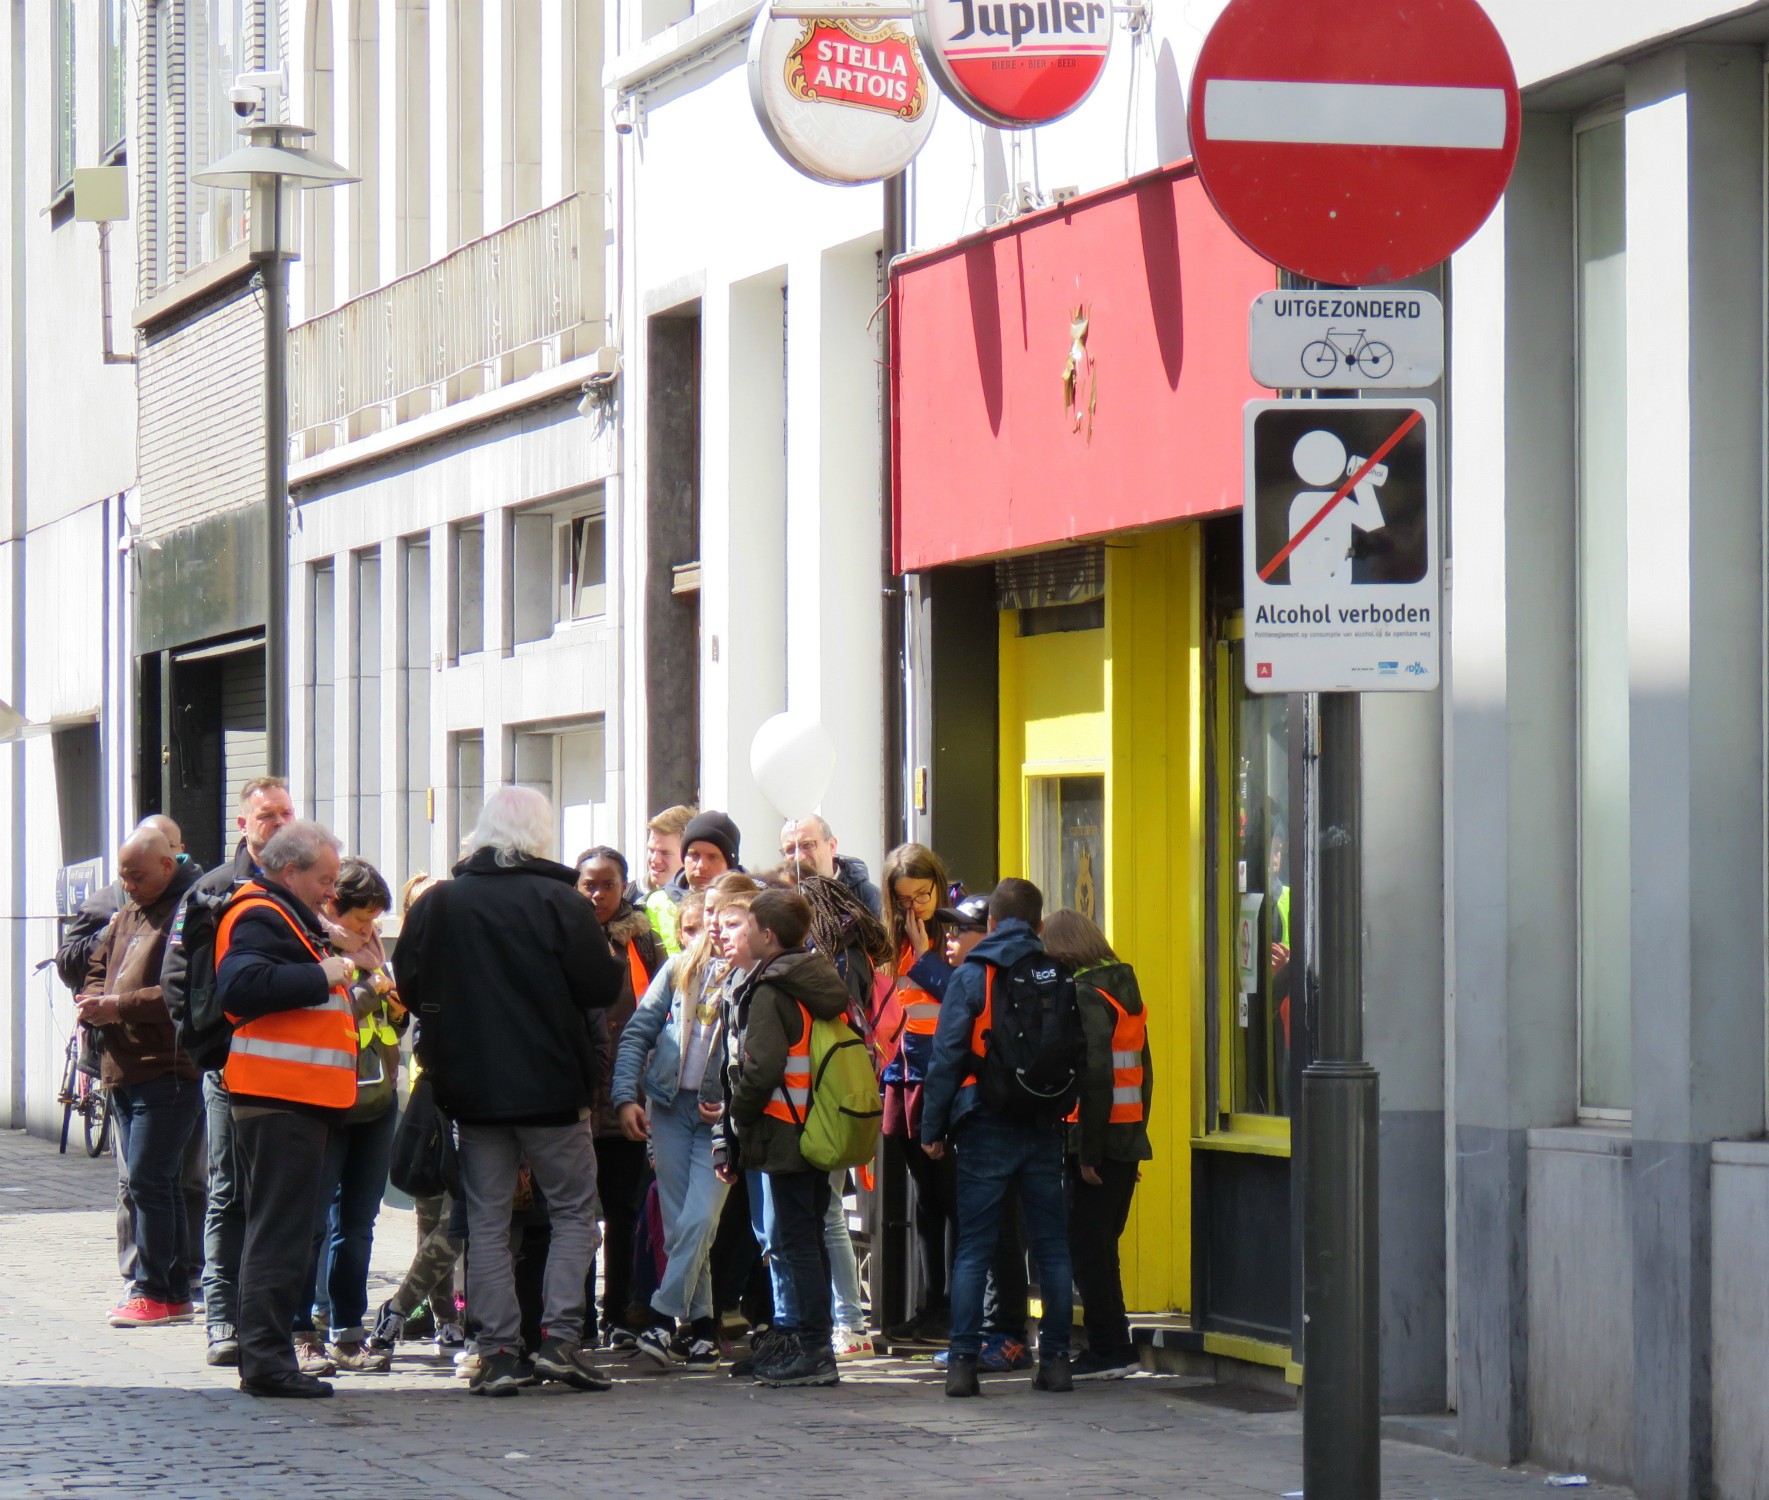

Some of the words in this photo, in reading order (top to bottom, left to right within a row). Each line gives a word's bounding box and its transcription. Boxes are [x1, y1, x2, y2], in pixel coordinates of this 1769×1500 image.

[947, 0, 1105, 48] Jupiler
[817, 39, 908, 77] STELLA
[1028, 59, 1047, 69] BIER
[1057, 58, 1077, 68] BEER
[813, 66, 908, 102] ARTOIS
[1274, 299, 1421, 319] UITGEZONDERD
[1255, 604, 1331, 624] Alcohol
[1338, 603, 1431, 624] verboden
